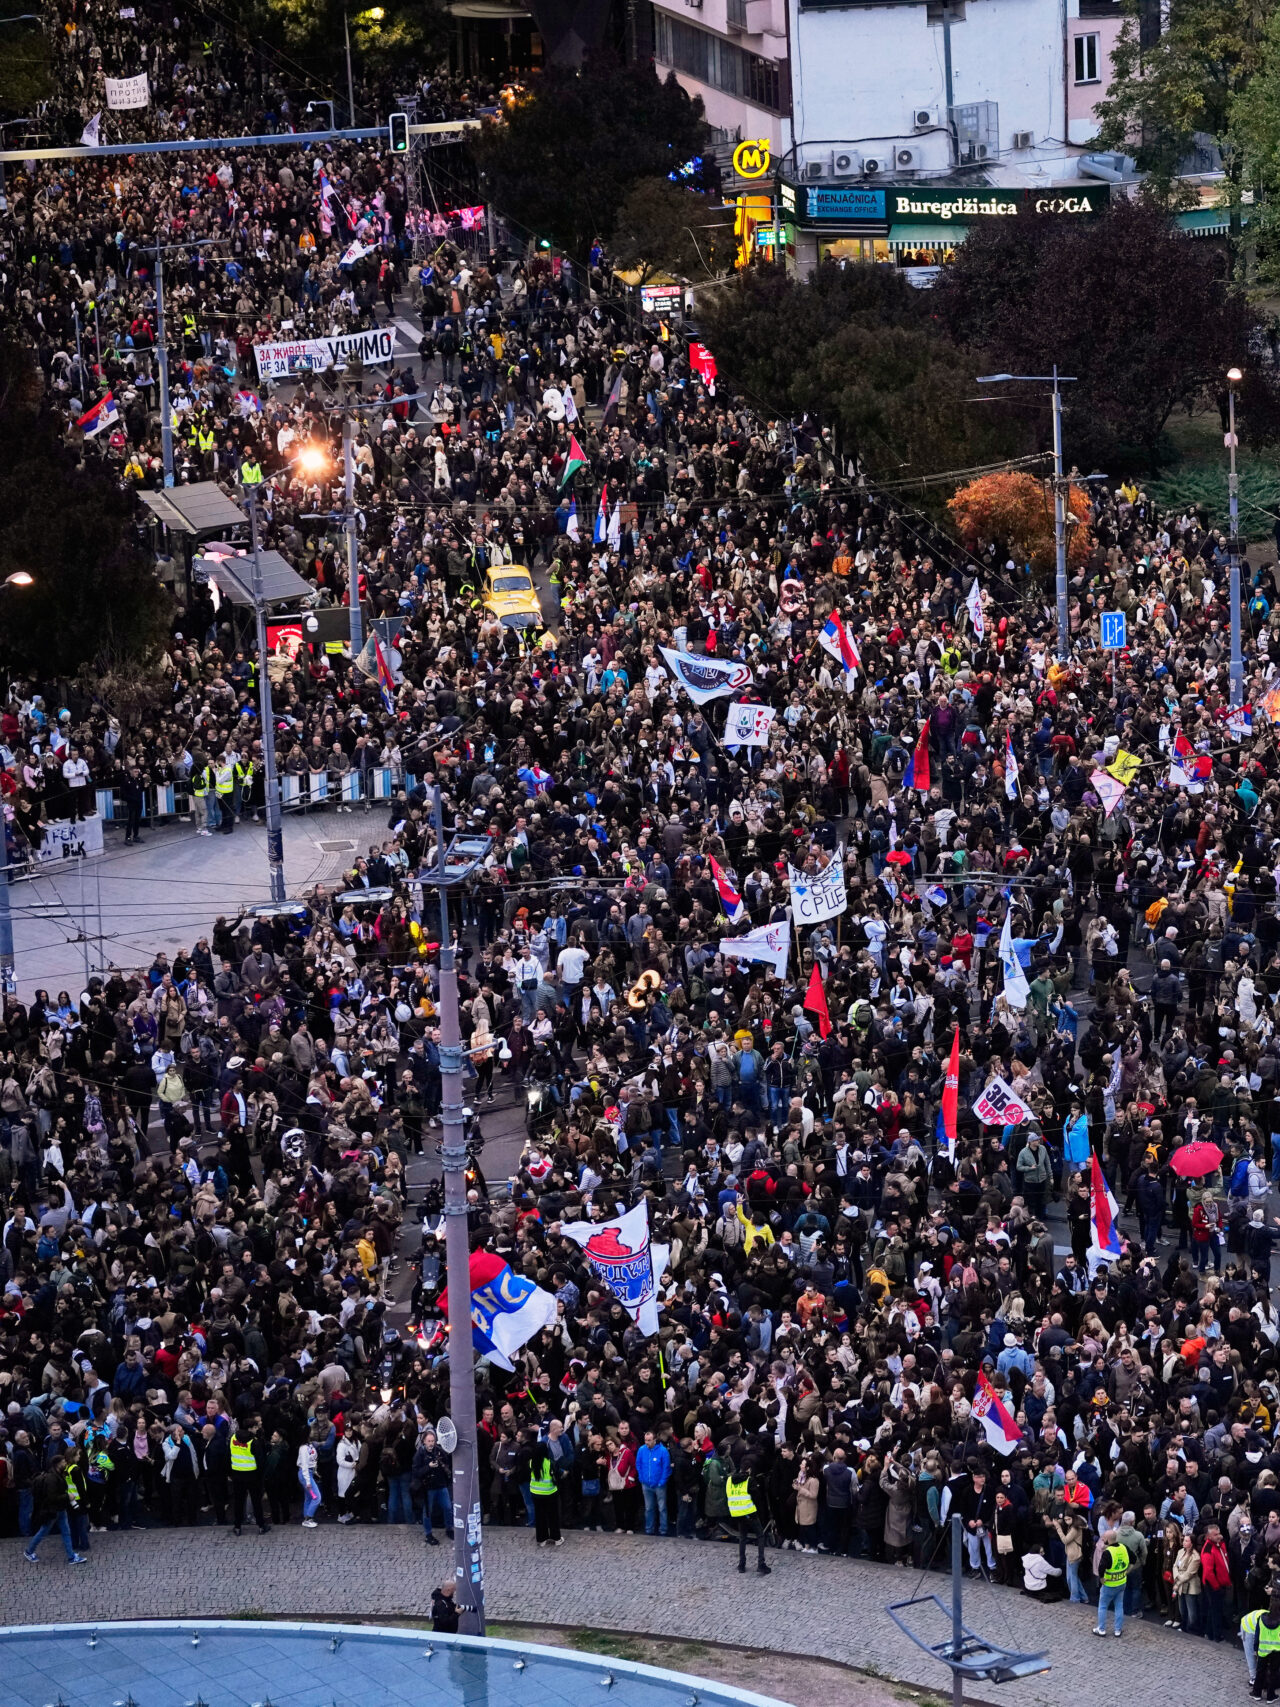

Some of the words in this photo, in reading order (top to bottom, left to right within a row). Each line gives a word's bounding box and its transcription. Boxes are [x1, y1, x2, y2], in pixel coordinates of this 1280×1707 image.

[110, 86, 147, 97] ПРОТИВ
[817, 193, 877, 204] MENJAČNICA
[896, 197, 1018, 219] Buregdžinica
[1036, 197, 1093, 214] GOGA
[260, 349, 271, 361] ЗА
[328, 332, 392, 366] УЧИМО
[260, 361, 272, 373] НЕ
[275, 361, 286, 371] ЗА
[800, 885, 846, 917] СРЦЕ
